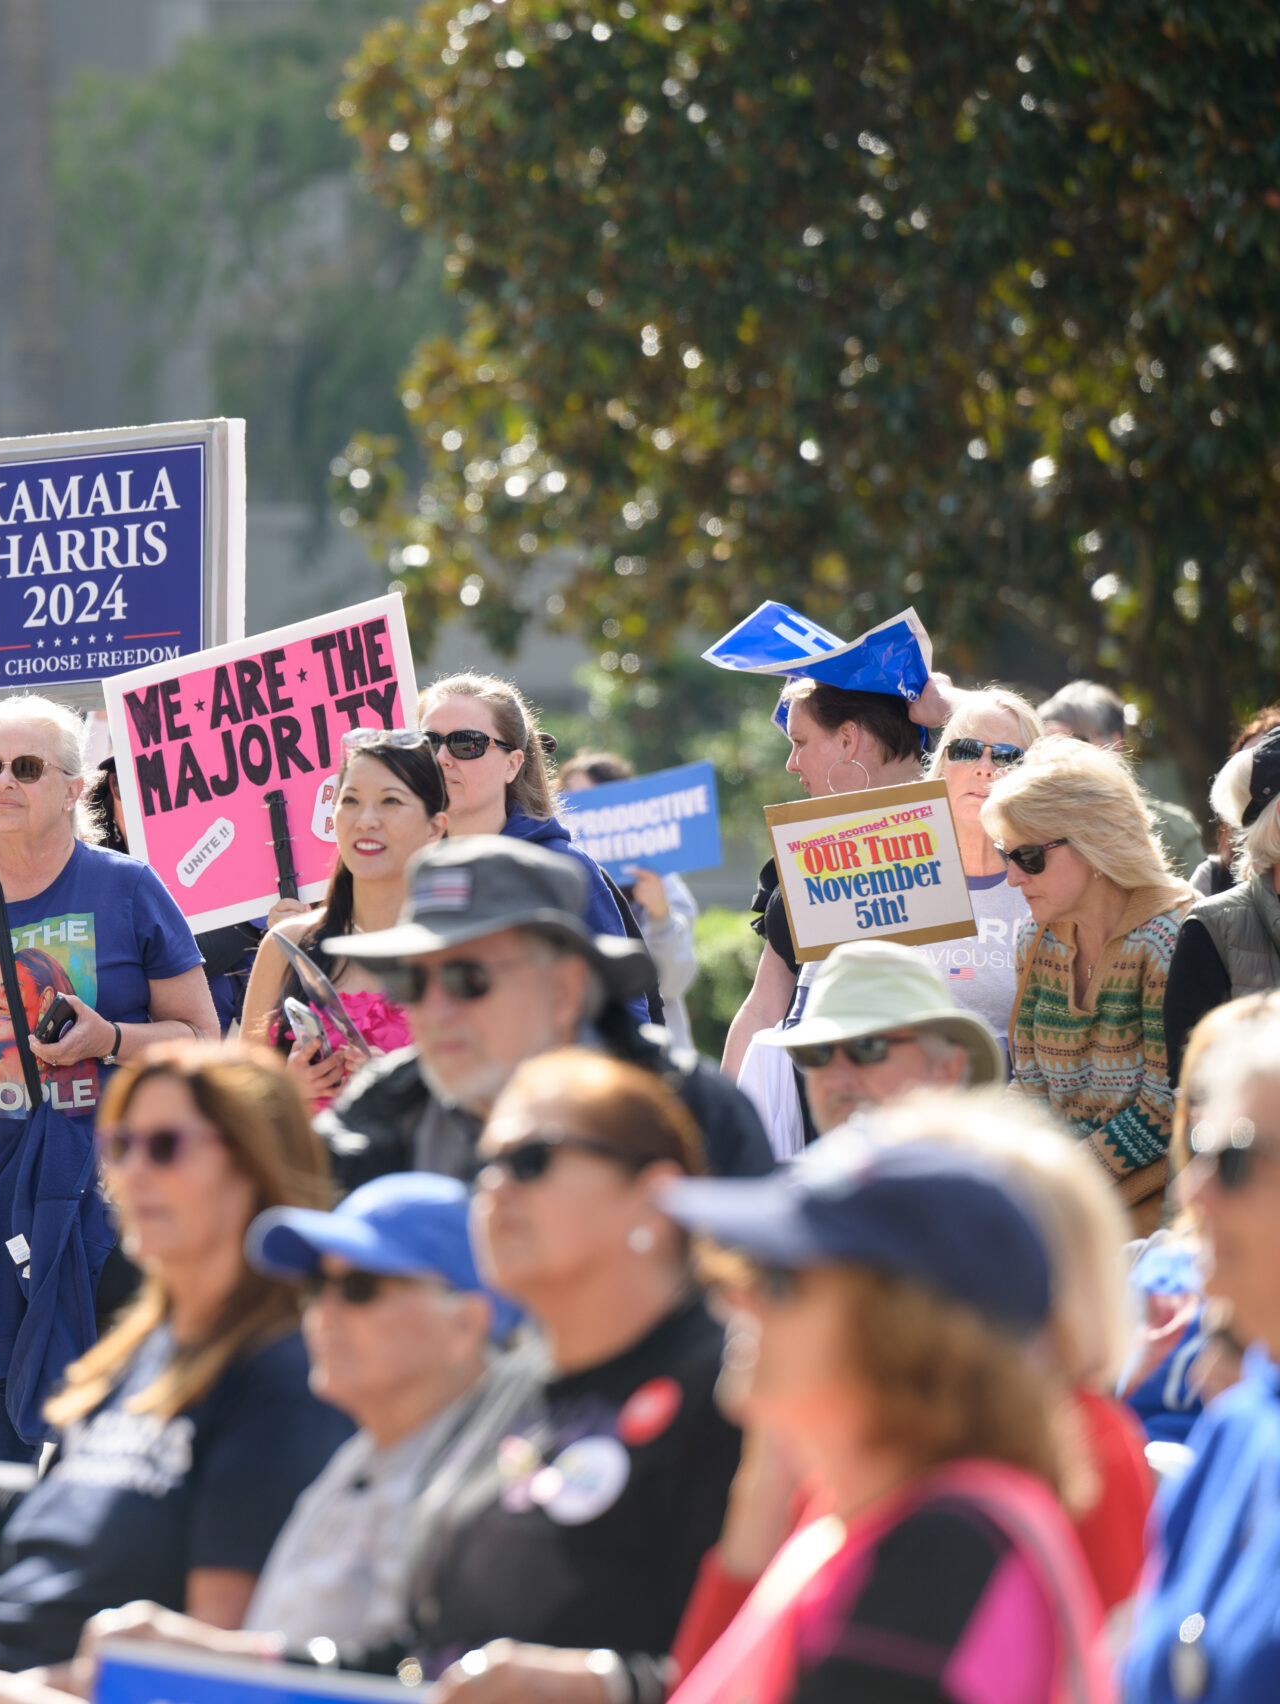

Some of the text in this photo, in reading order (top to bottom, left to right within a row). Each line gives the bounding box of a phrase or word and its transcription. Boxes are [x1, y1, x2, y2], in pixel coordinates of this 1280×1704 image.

[22, 574, 128, 628] 2024
[4, 654, 82, 677] CHOOSE
[86, 645, 181, 669] FREEDOM
[123, 619, 394, 748] WE ARE THE
[135, 681, 399, 817] MAJORITY
[787, 805, 933, 852] Women scorned VOTE!
[183, 836, 221, 875] UNITE
[803, 831, 934, 875] OUR Turn
[803, 860, 942, 905] November
[854, 894, 909, 929] 5th!
[22, 920, 89, 949] THE
[923, 947, 1017, 969] VIOUSL
